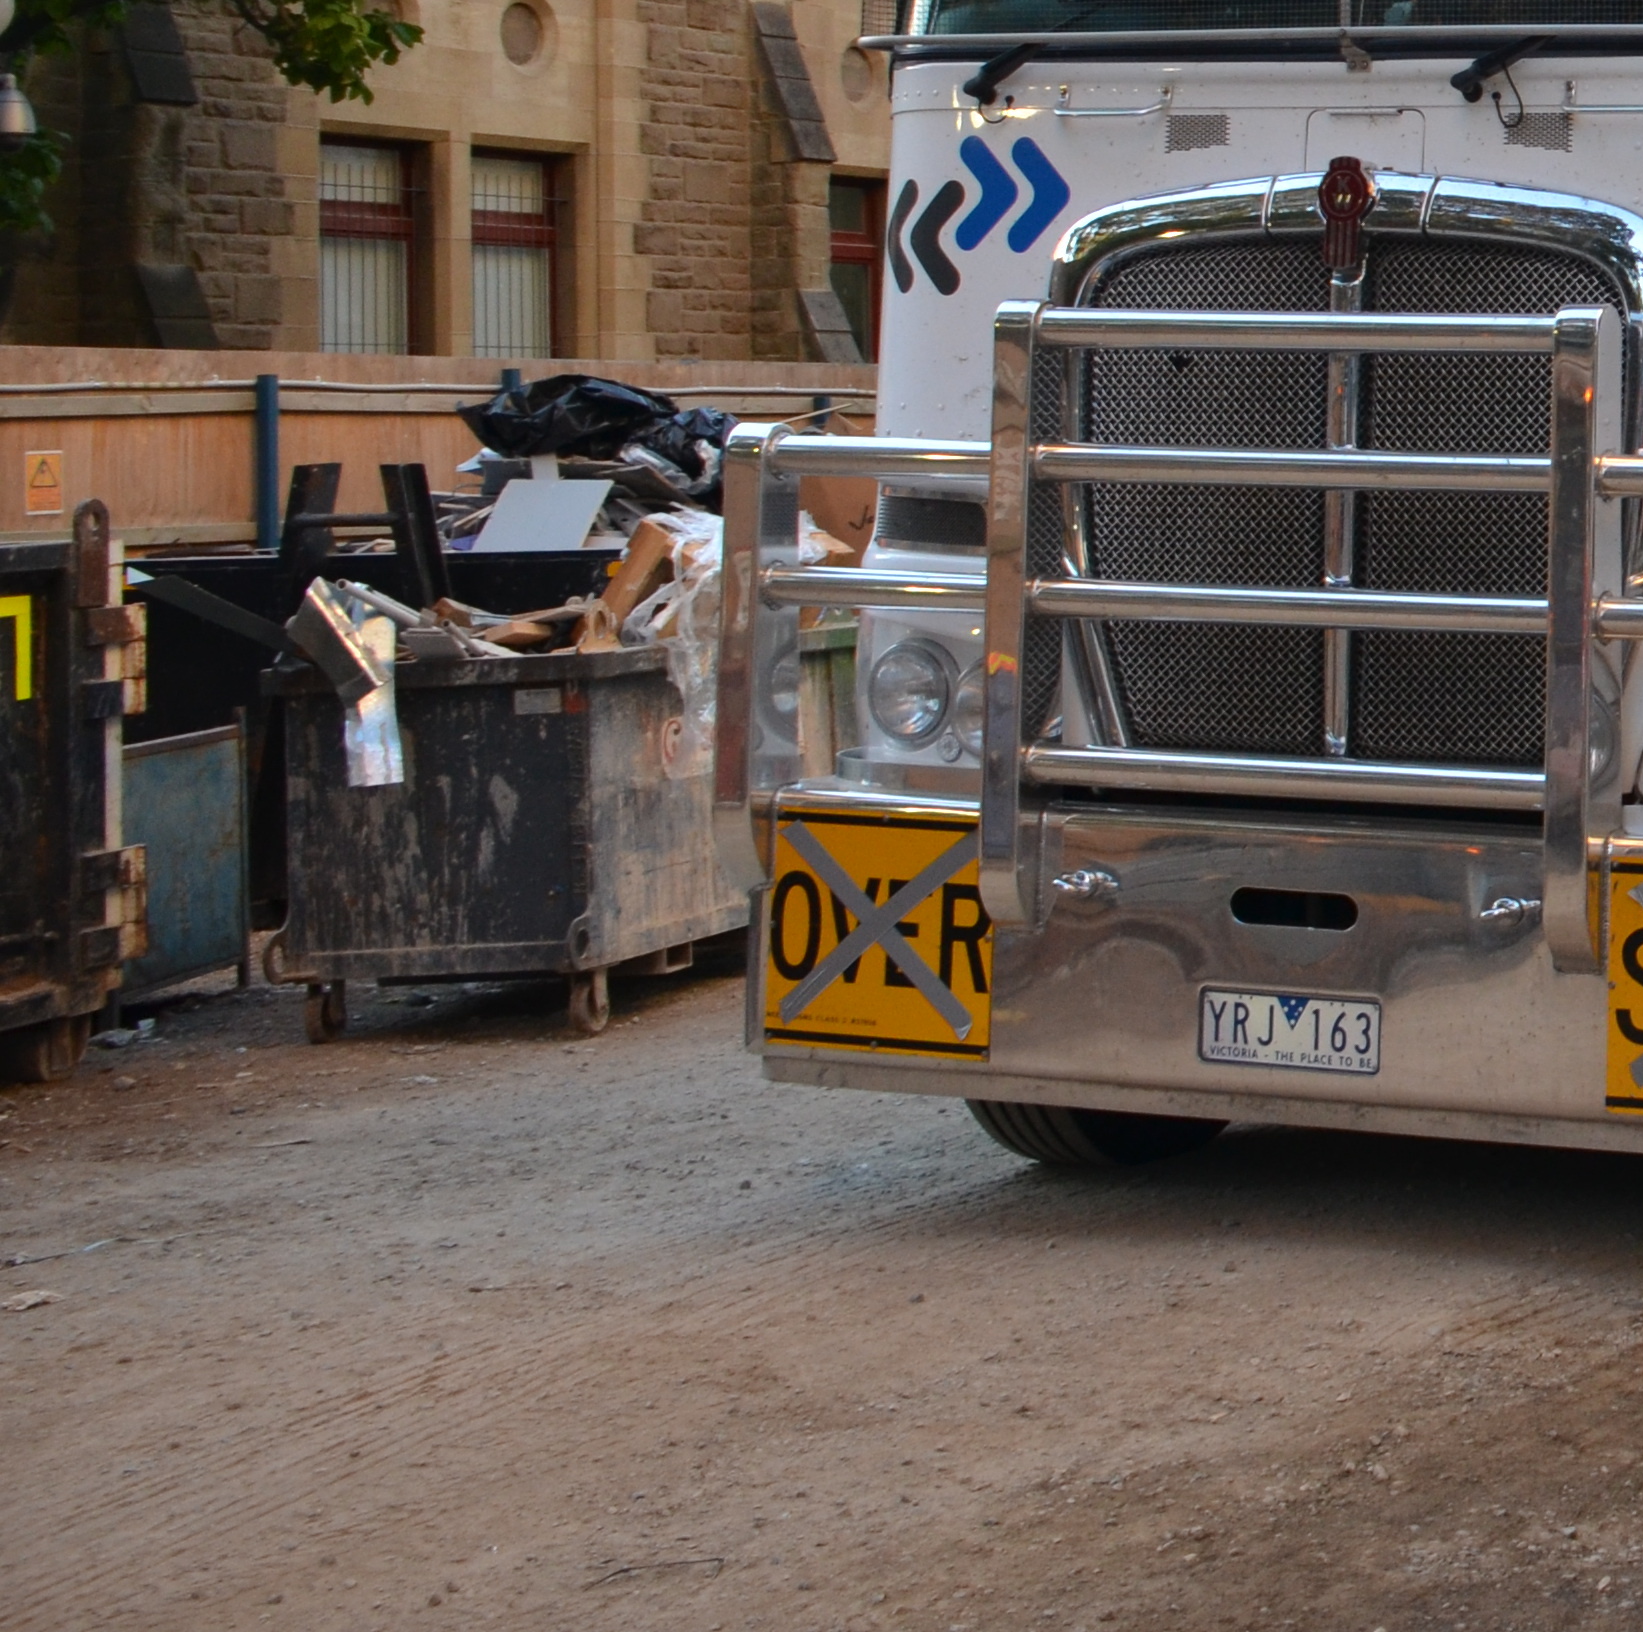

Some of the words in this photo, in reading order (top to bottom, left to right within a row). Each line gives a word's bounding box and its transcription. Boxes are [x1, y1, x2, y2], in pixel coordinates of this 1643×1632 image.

[1208, 999, 1275, 1047] YRJ
[1311, 1007, 1372, 1055] 163
[1209, 1044, 1259, 1060] VICTORIA
[1274, 1050, 1294, 1063] THE
[1300, 1052, 1333, 1066] PLACE
[1339, 1055, 1353, 1067] TO
[1359, 1057, 1372, 1069] BE
